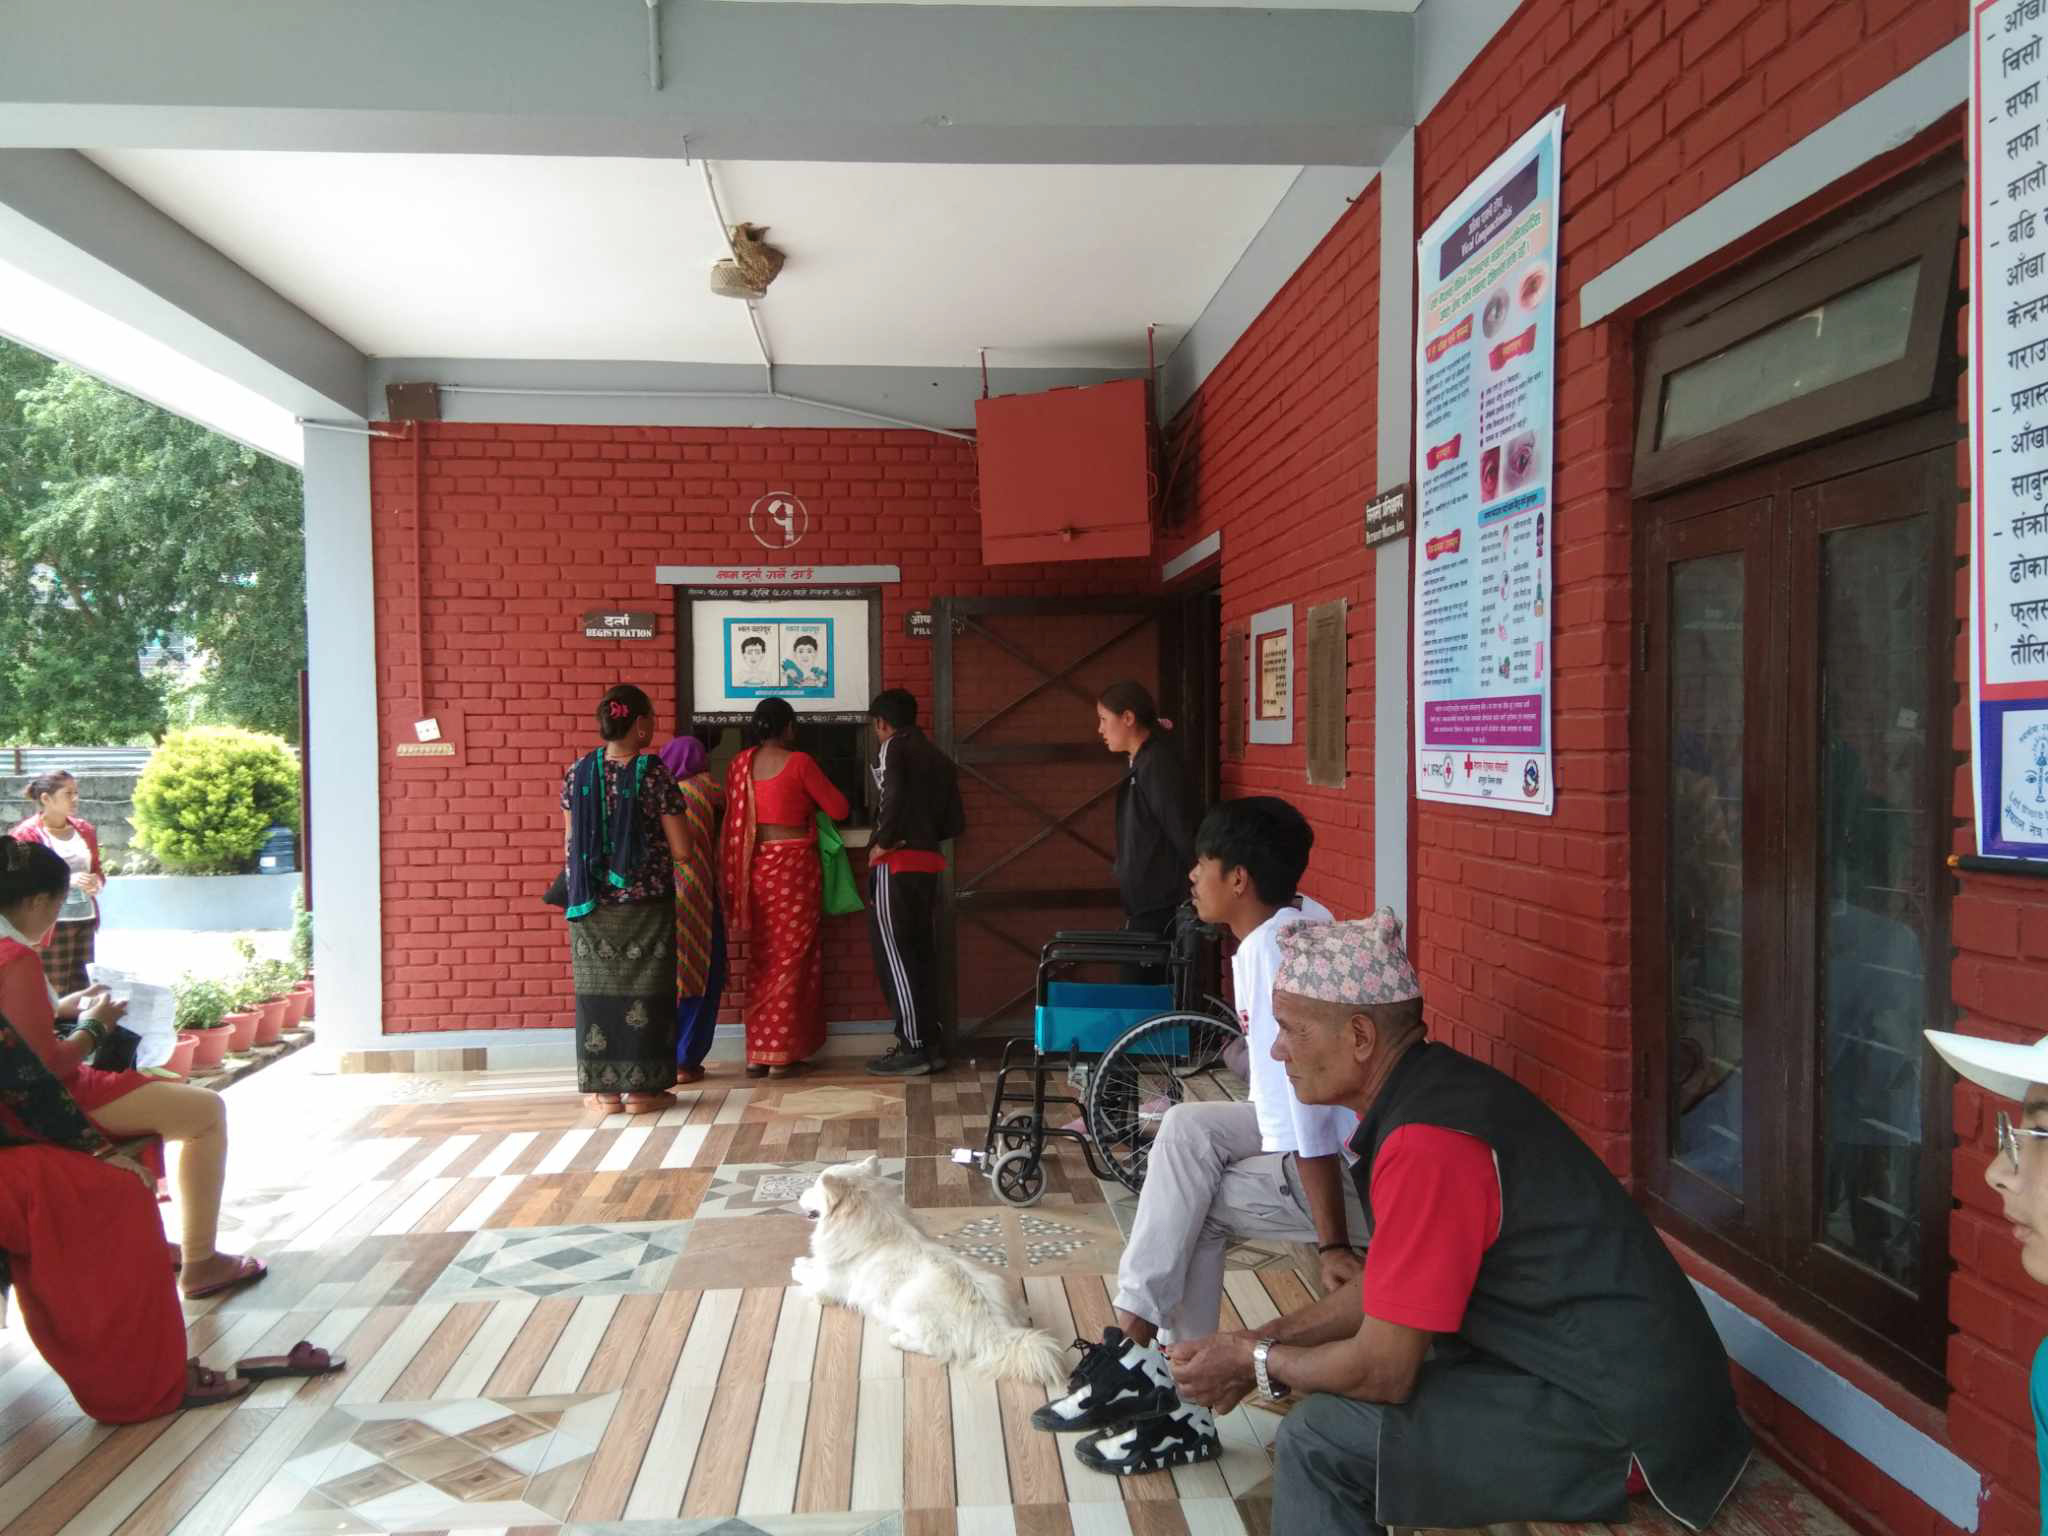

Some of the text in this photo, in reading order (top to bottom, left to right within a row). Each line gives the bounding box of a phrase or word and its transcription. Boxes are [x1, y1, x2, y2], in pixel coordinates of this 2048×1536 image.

[2004, 81, 2041, 118] सफा
[2005, 123, 2041, 161] सफा
[2007, 160, 2047, 201] कालो
[2007, 209, 2037, 244] बढि
[2006, 252, 2046, 287] आँखा
[2007, 338, 2048, 371] गराउ
[585, 628, 653, 639] REGISTRATION
[2009, 634, 2048, 666] तौलि
